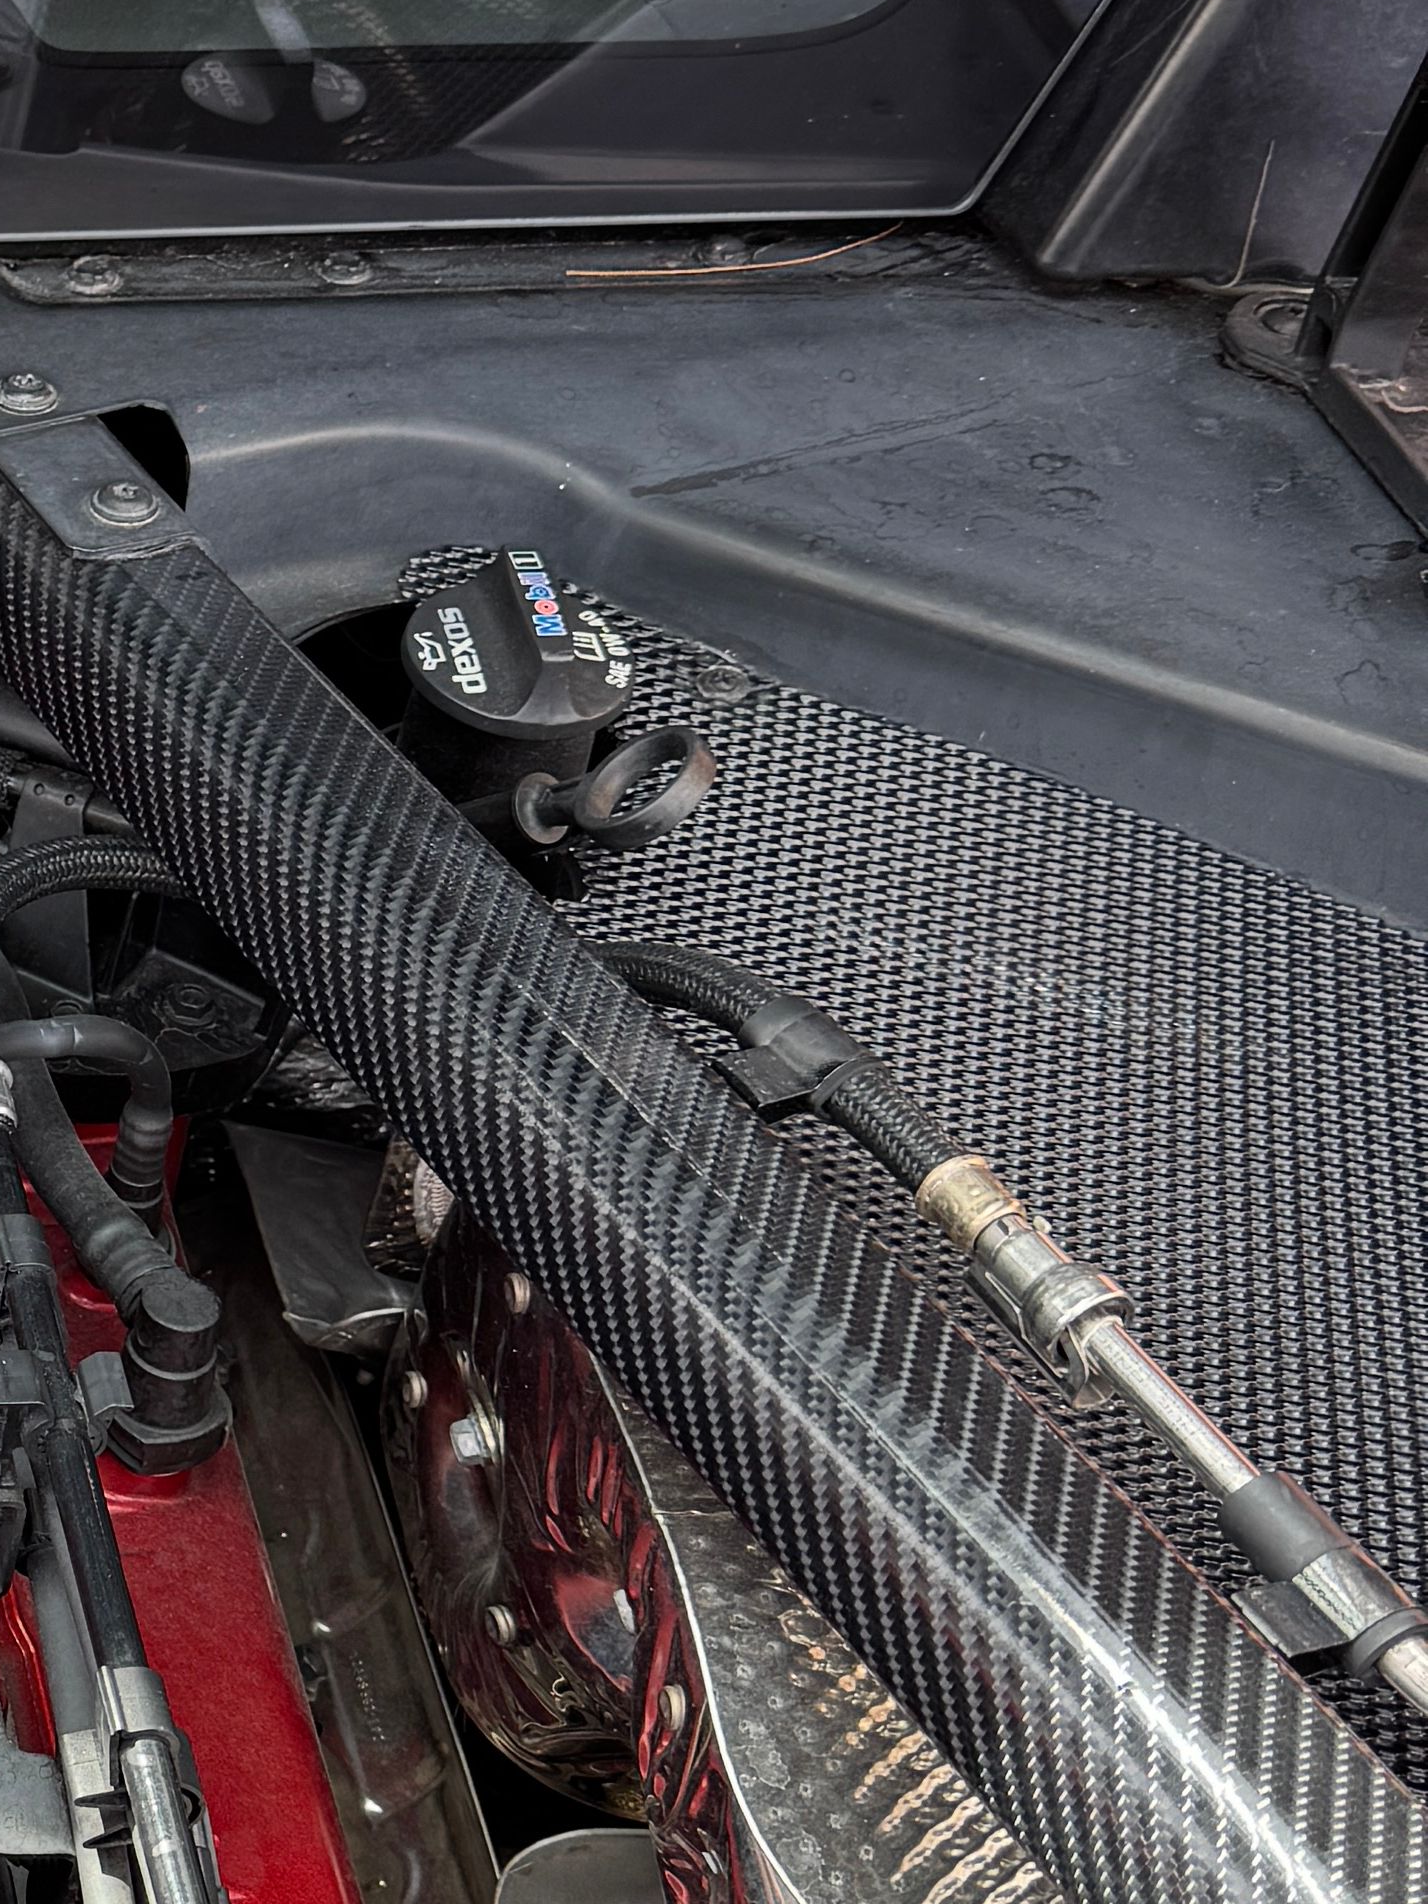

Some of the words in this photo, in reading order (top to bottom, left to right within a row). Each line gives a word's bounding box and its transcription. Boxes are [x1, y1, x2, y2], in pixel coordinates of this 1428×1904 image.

[517, 572, 568, 636] Mobil
[437, 607, 487, 694] dexos
[605, 660, 632, 689] SAE
